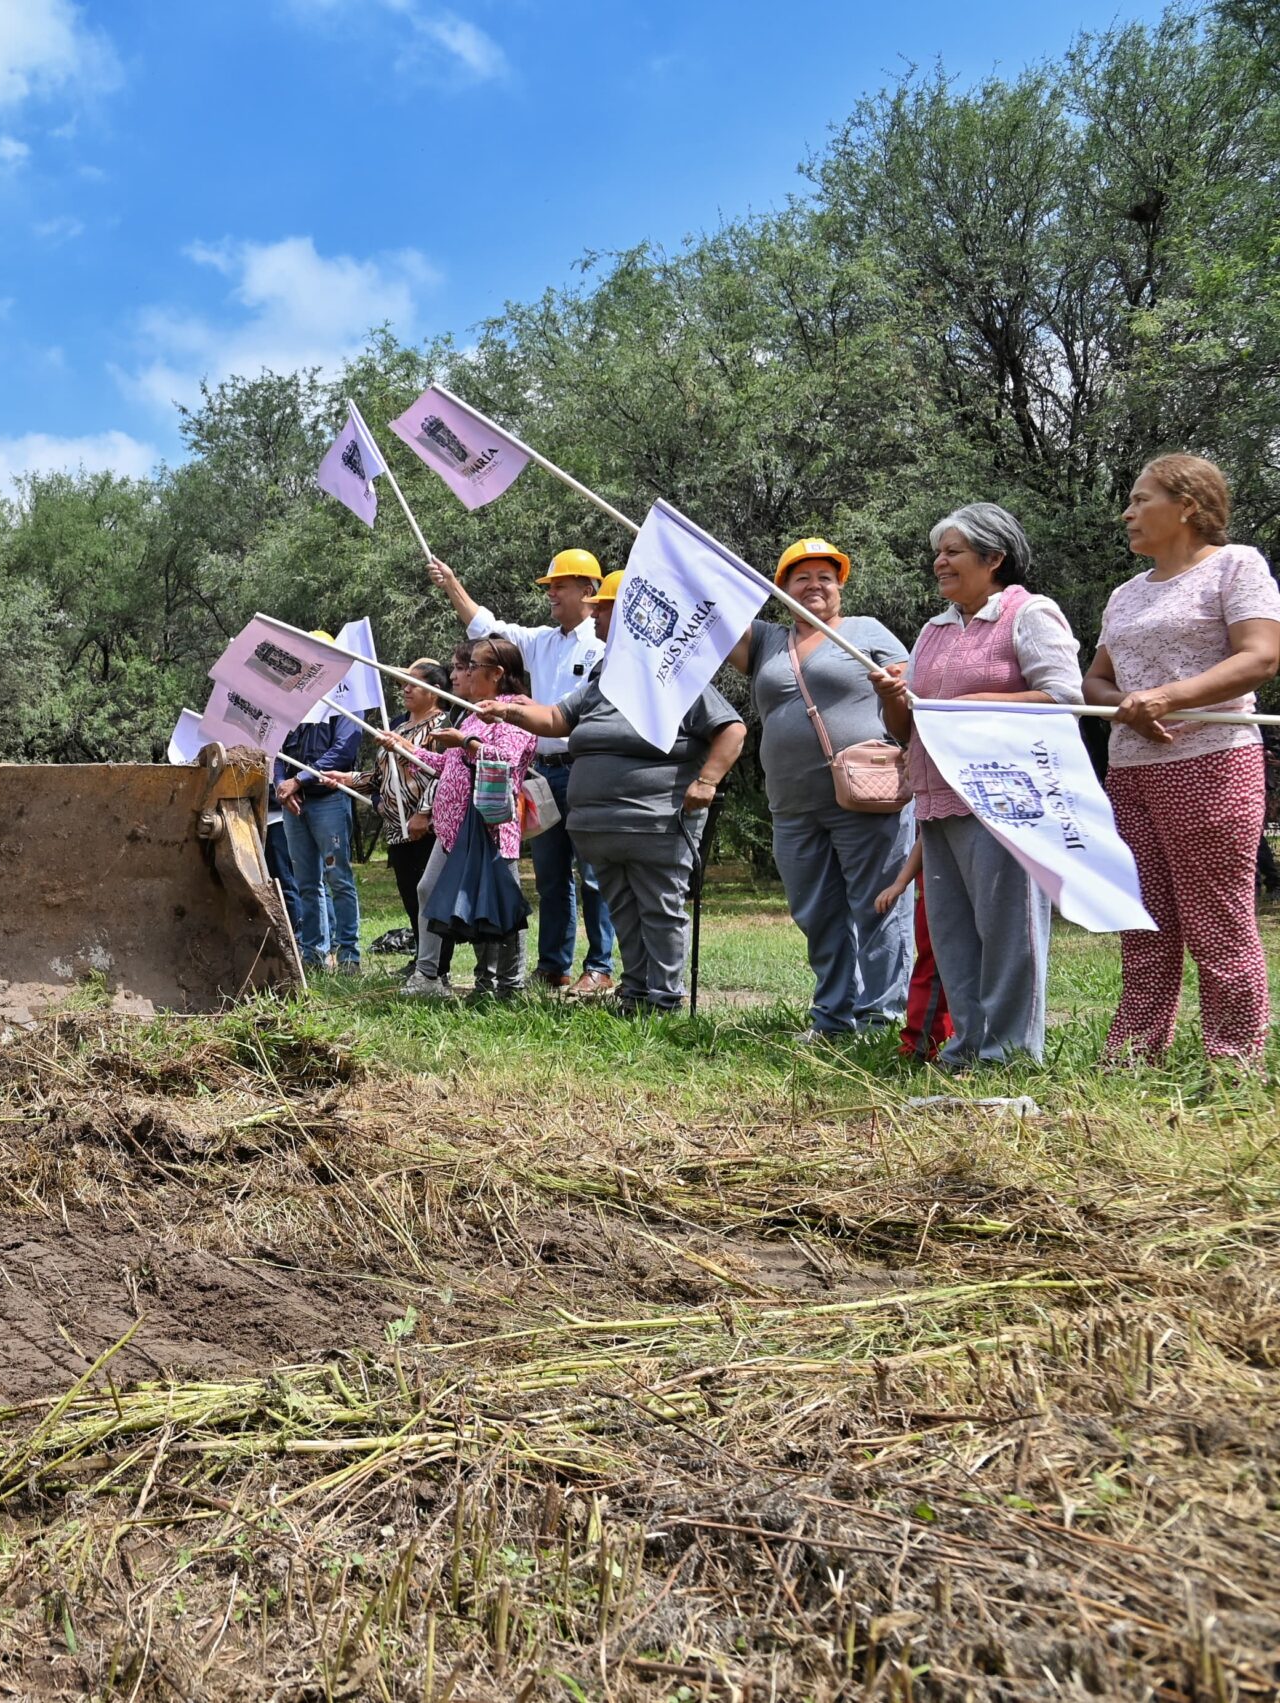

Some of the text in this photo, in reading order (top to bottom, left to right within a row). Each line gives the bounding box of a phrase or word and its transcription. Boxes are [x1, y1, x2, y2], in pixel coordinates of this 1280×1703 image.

[656, 599, 717, 688] JESÚS MARÍA
[687, 613, 719, 651] MUNICIPAL
